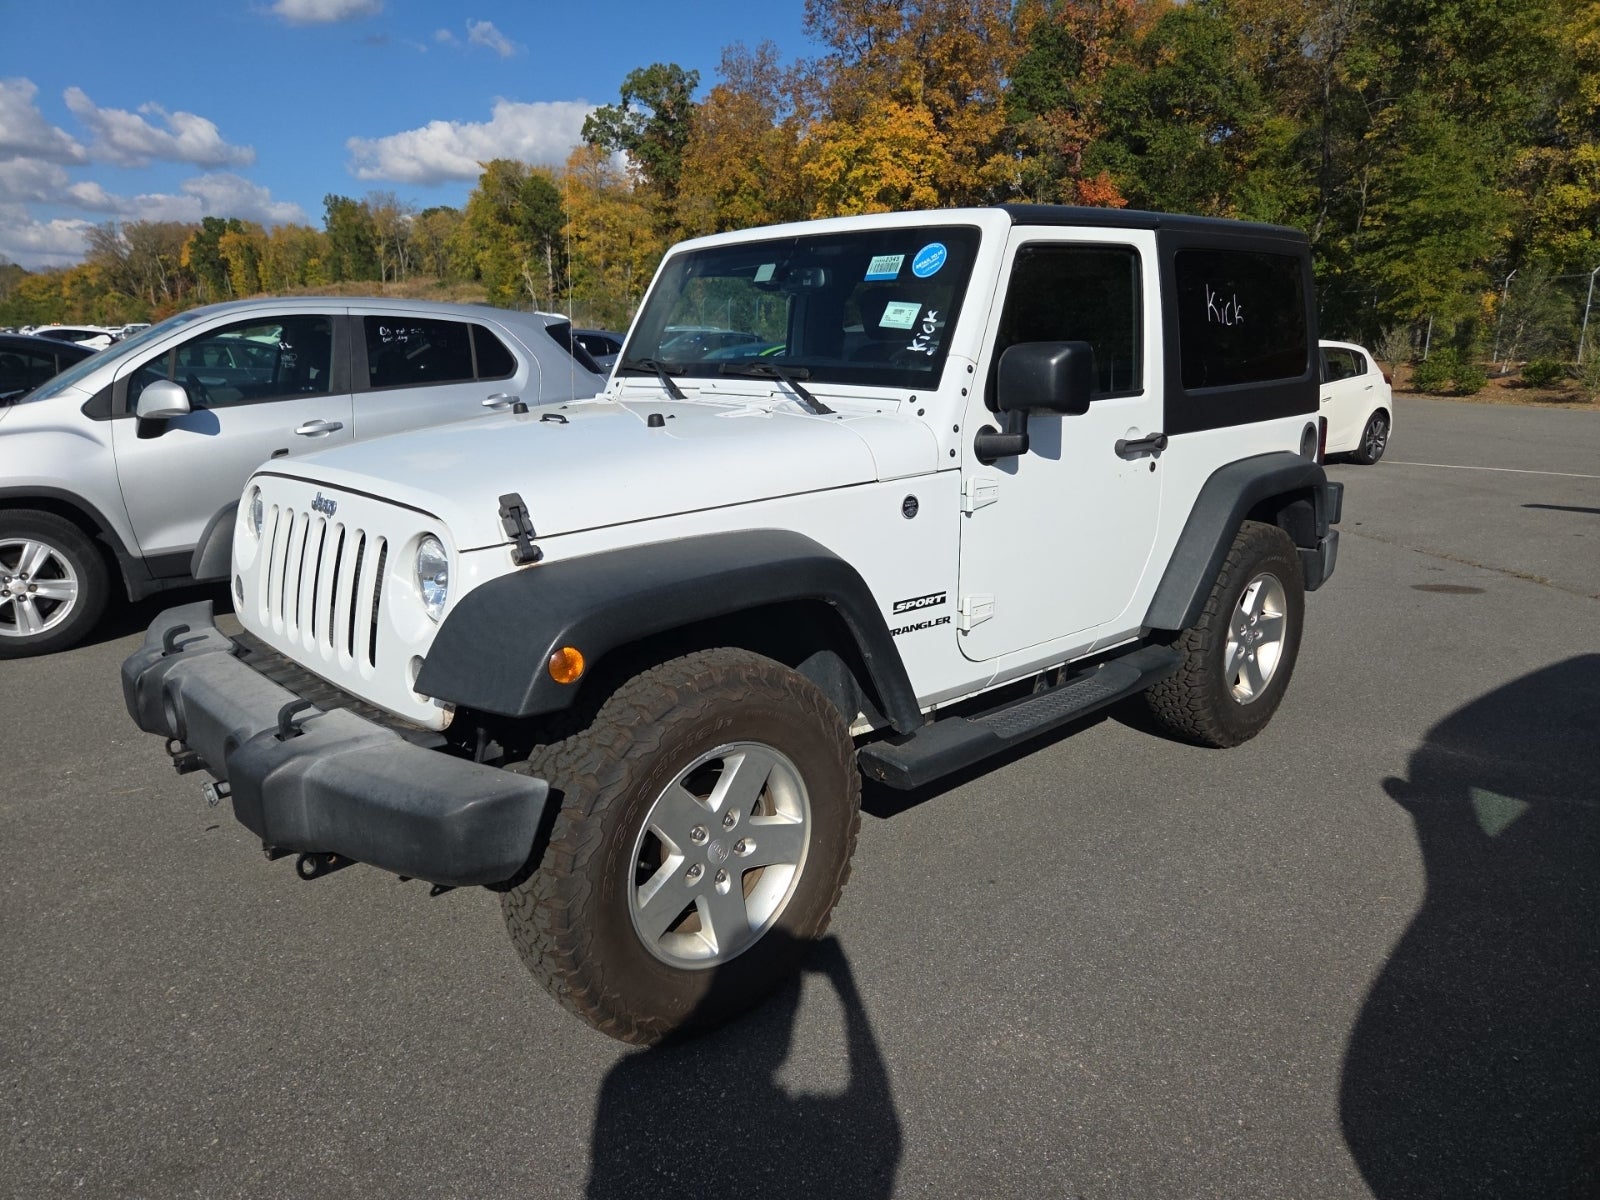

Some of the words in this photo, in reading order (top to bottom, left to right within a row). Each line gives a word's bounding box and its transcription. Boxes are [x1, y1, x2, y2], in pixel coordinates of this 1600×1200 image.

[1206, 283, 1244, 326] Kick
[311, 491, 338, 519] Jeep
[893, 592, 946, 614] SPORT
[890, 616, 951, 637] RANGLER
